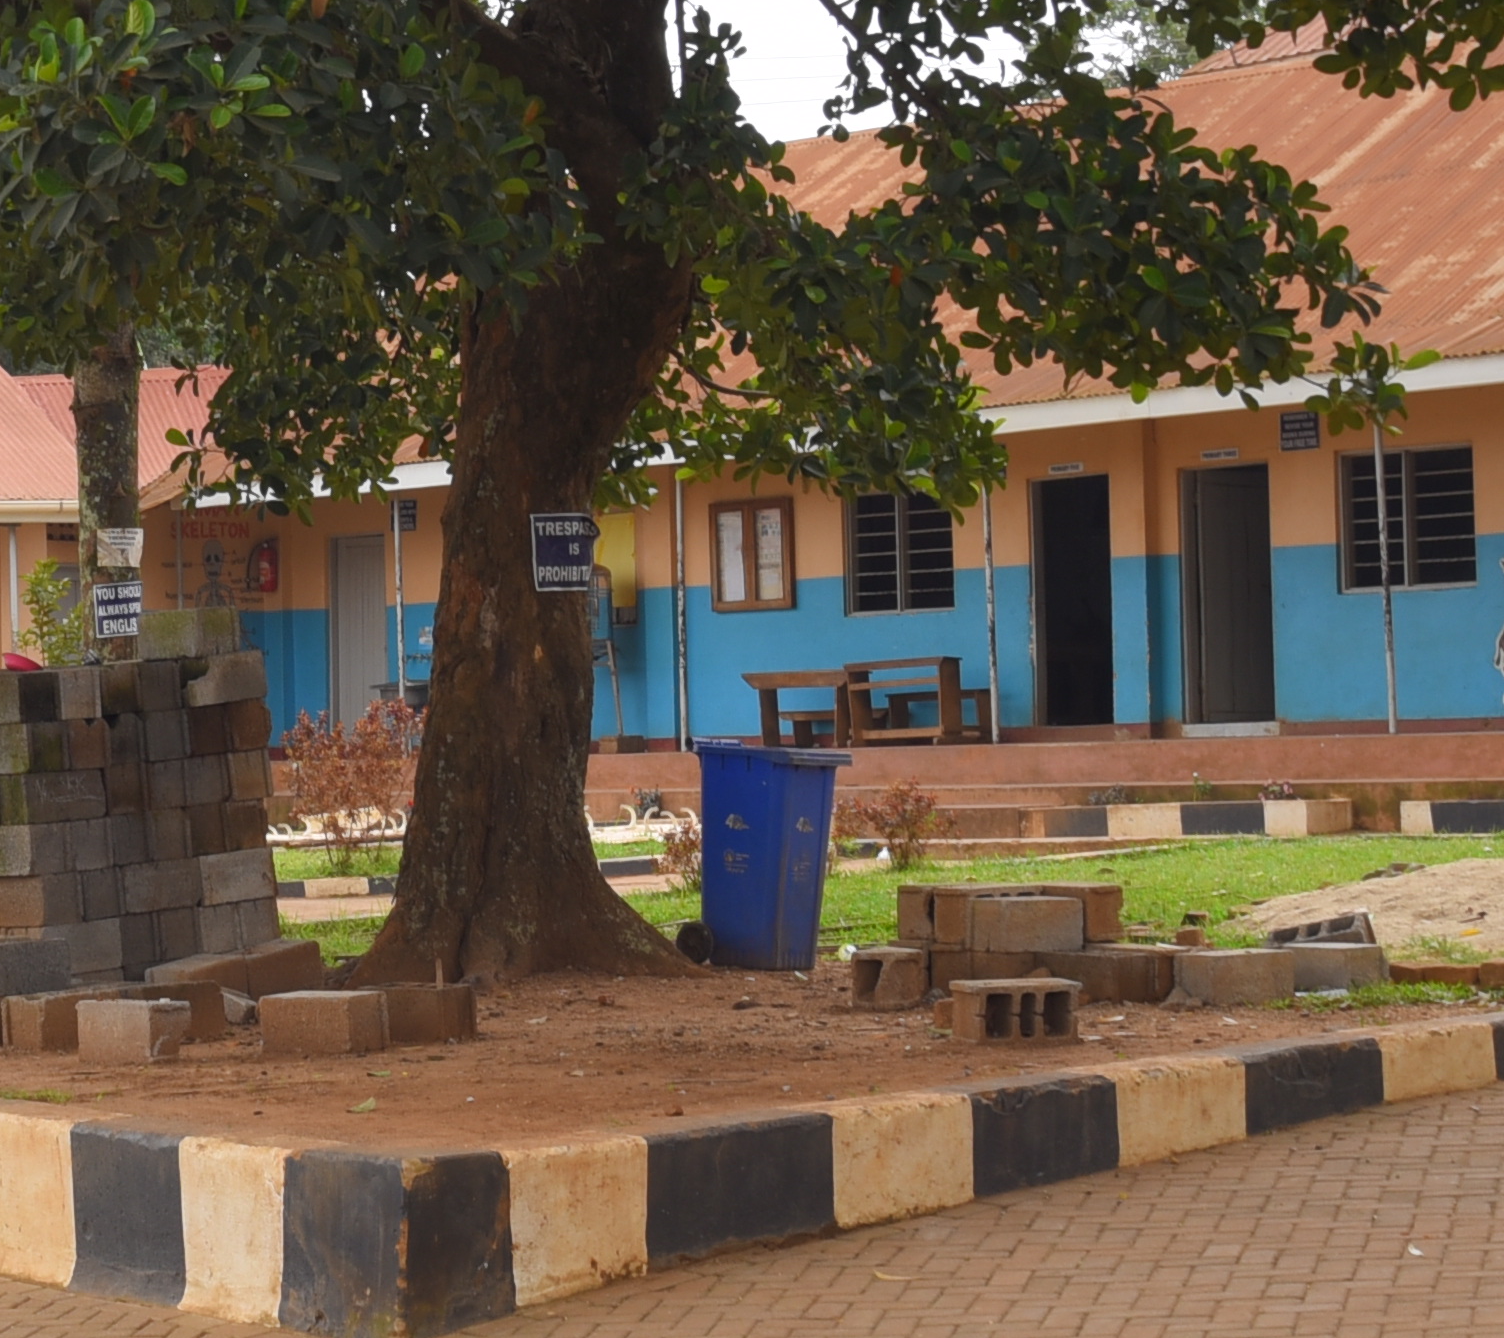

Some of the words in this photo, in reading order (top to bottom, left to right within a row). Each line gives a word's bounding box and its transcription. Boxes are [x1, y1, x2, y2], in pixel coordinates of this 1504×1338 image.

[170, 521, 250, 539] SKELETON
[568, 542, 580, 556] IS
[96, 586, 115, 601] YOU
[98, 603, 128, 617] ALWAYS
